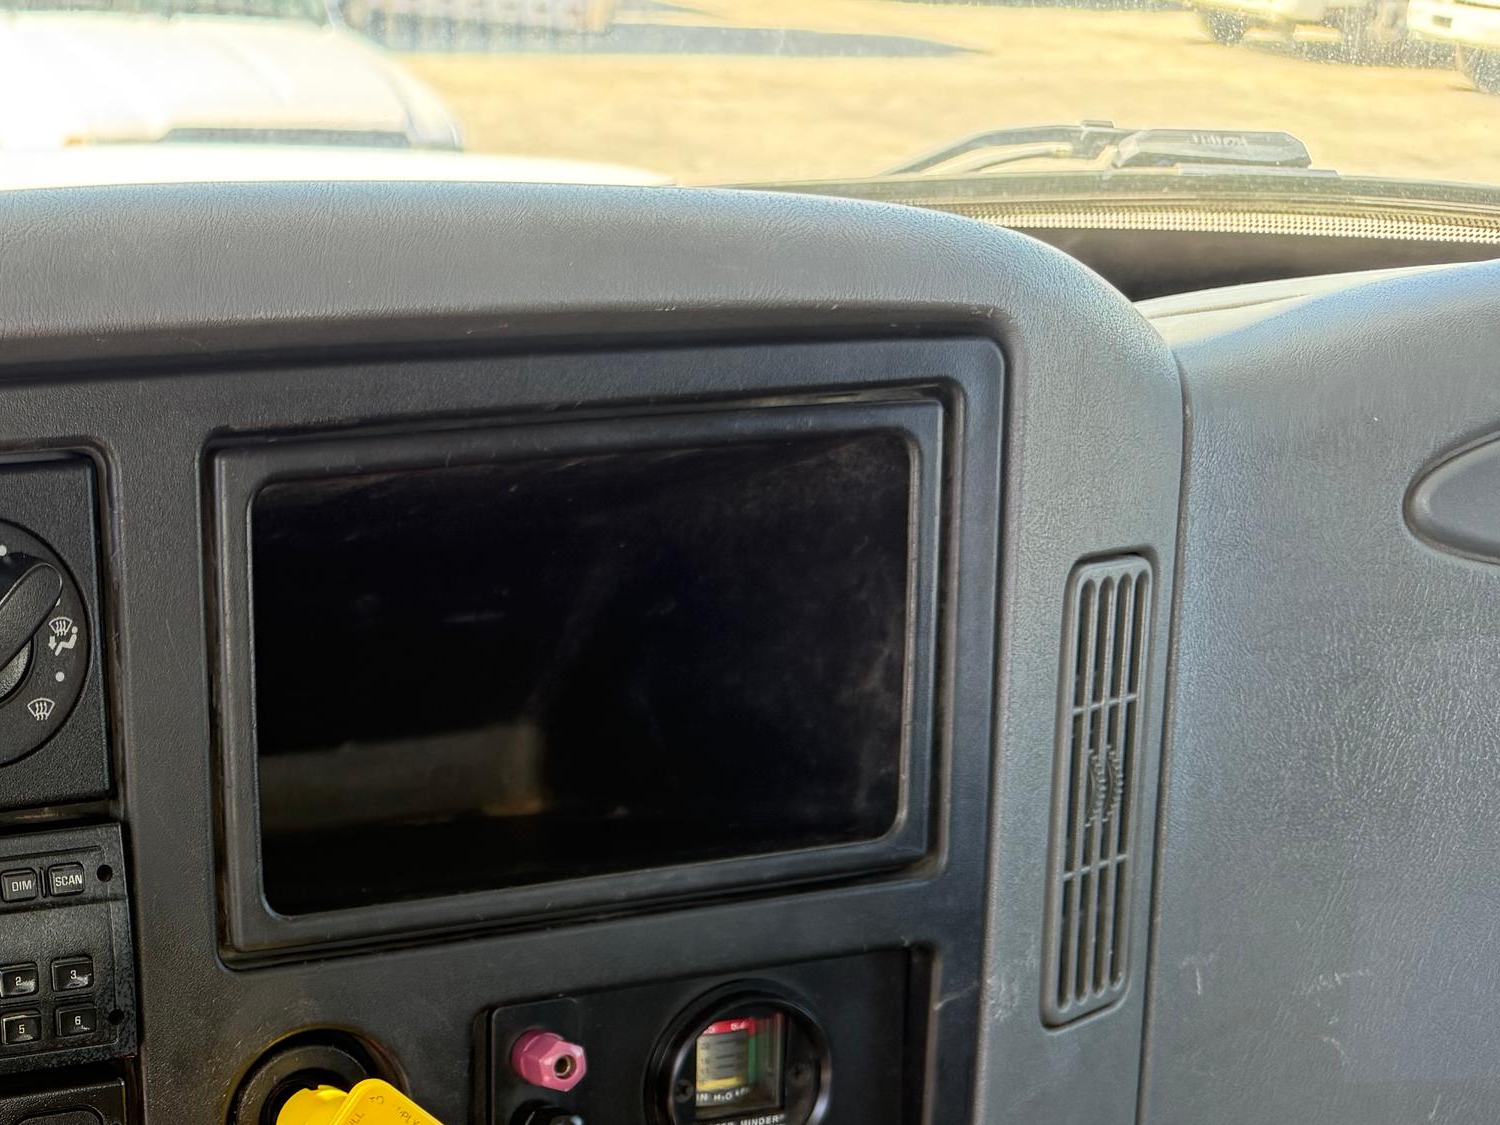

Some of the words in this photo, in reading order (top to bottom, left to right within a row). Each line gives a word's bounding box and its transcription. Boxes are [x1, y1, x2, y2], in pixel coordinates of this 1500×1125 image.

[12, 879, 33, 892] DIM
[55, 873, 83, 888] SCAN
[70, 969, 77, 980] 3
[16, 976, 22, 987] 2
[73, 1015, 81, 1027] 6
[18, 1023, 26, 1035] 5
